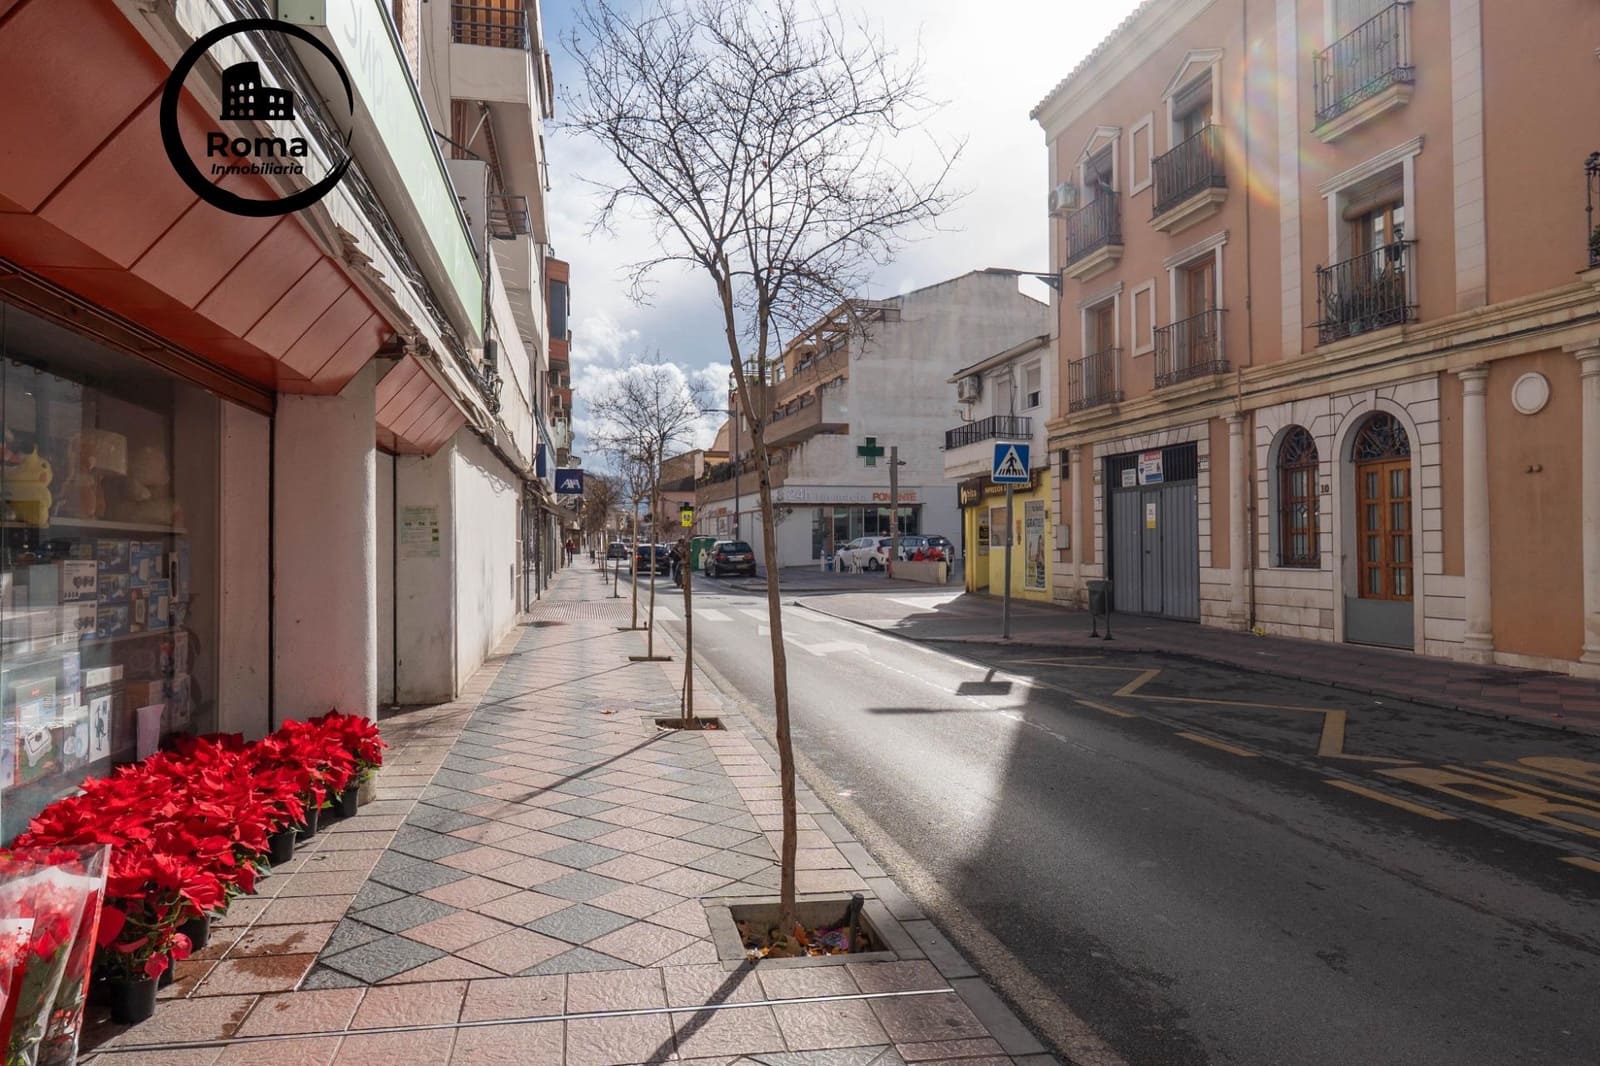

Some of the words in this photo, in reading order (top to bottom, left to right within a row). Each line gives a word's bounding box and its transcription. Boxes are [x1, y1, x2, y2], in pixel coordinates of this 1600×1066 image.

[560, 478, 581, 489] AXA
[1320, 484, 1330, 493] 10
[872, 492, 918, 502] PONENTE
